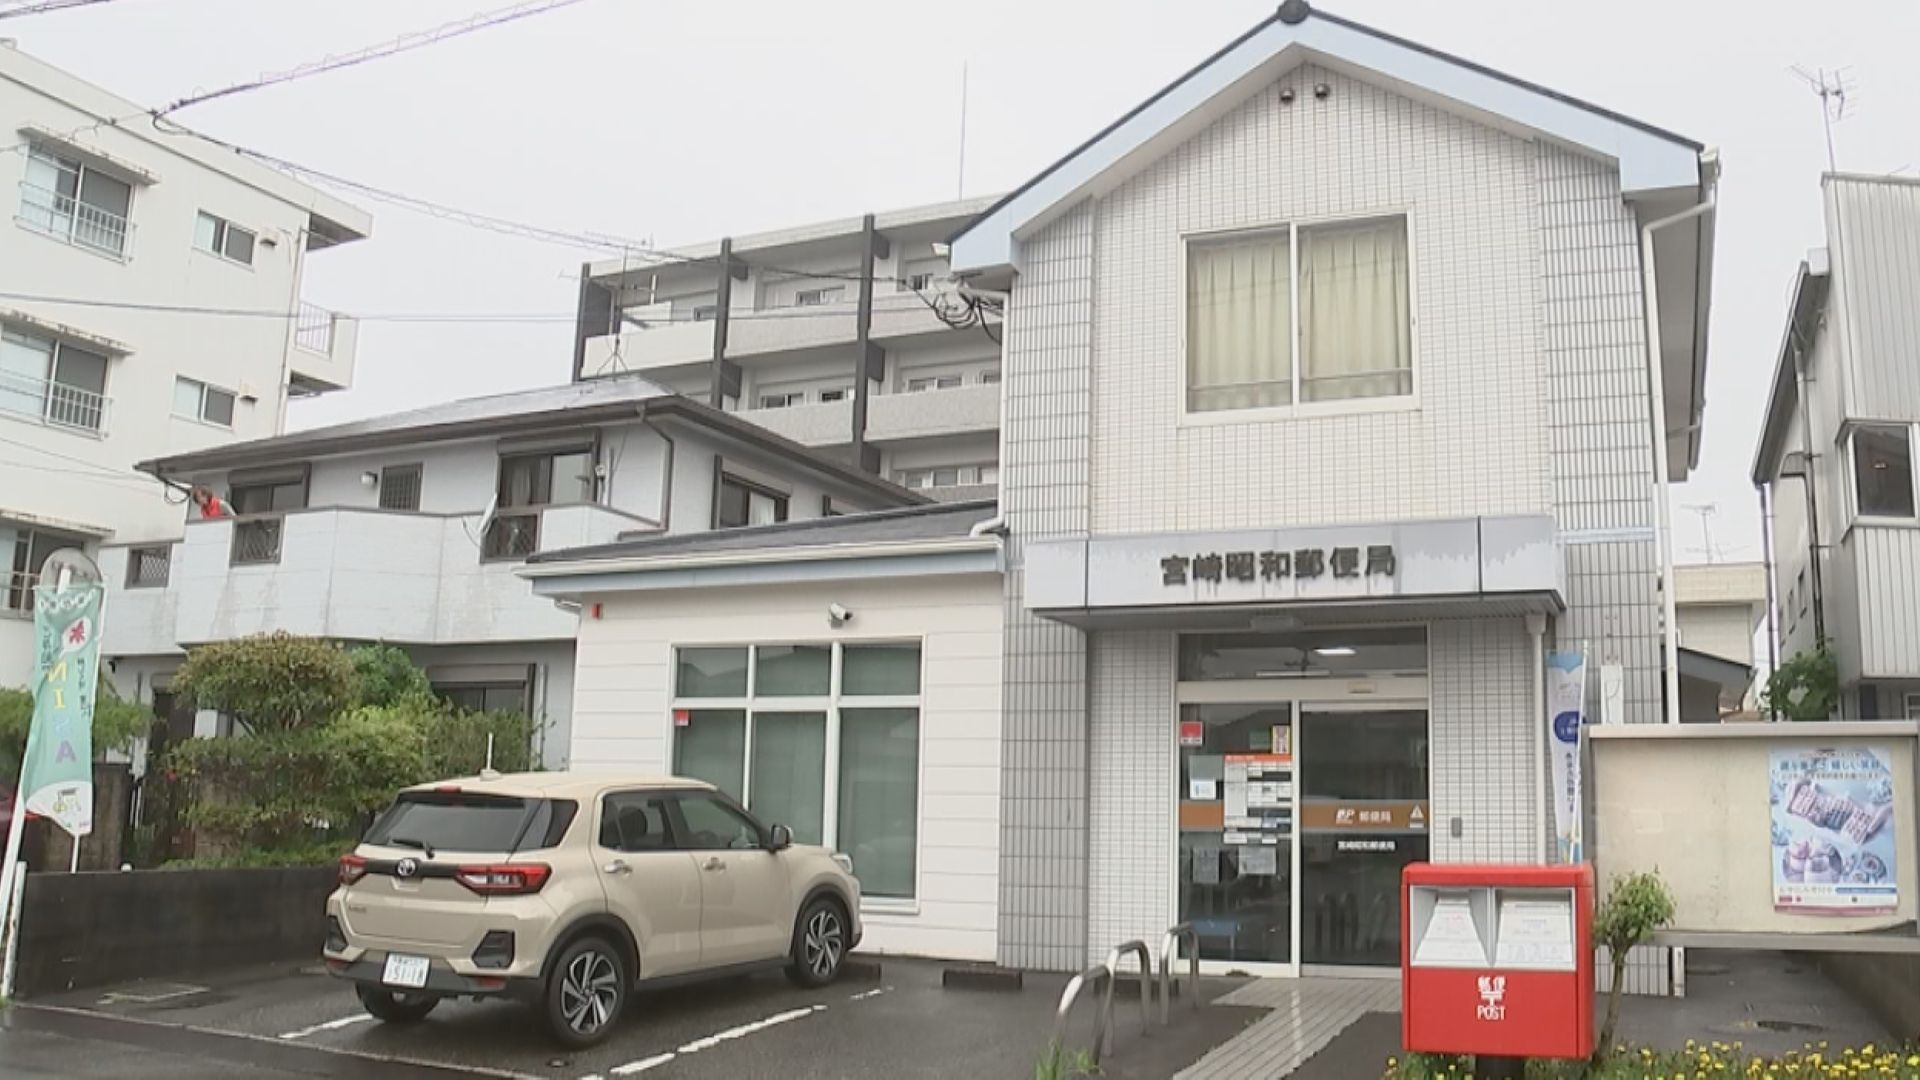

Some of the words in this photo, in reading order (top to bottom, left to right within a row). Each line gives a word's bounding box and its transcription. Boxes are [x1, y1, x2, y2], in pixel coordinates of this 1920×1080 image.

[1160, 546, 1394, 586] 宮崎昭和郵便局
[1359, 811, 1391, 823] 郵便局
[1477, 975, 1506, 990] 郵便
[1477, 1005, 1504, 1020] POST
